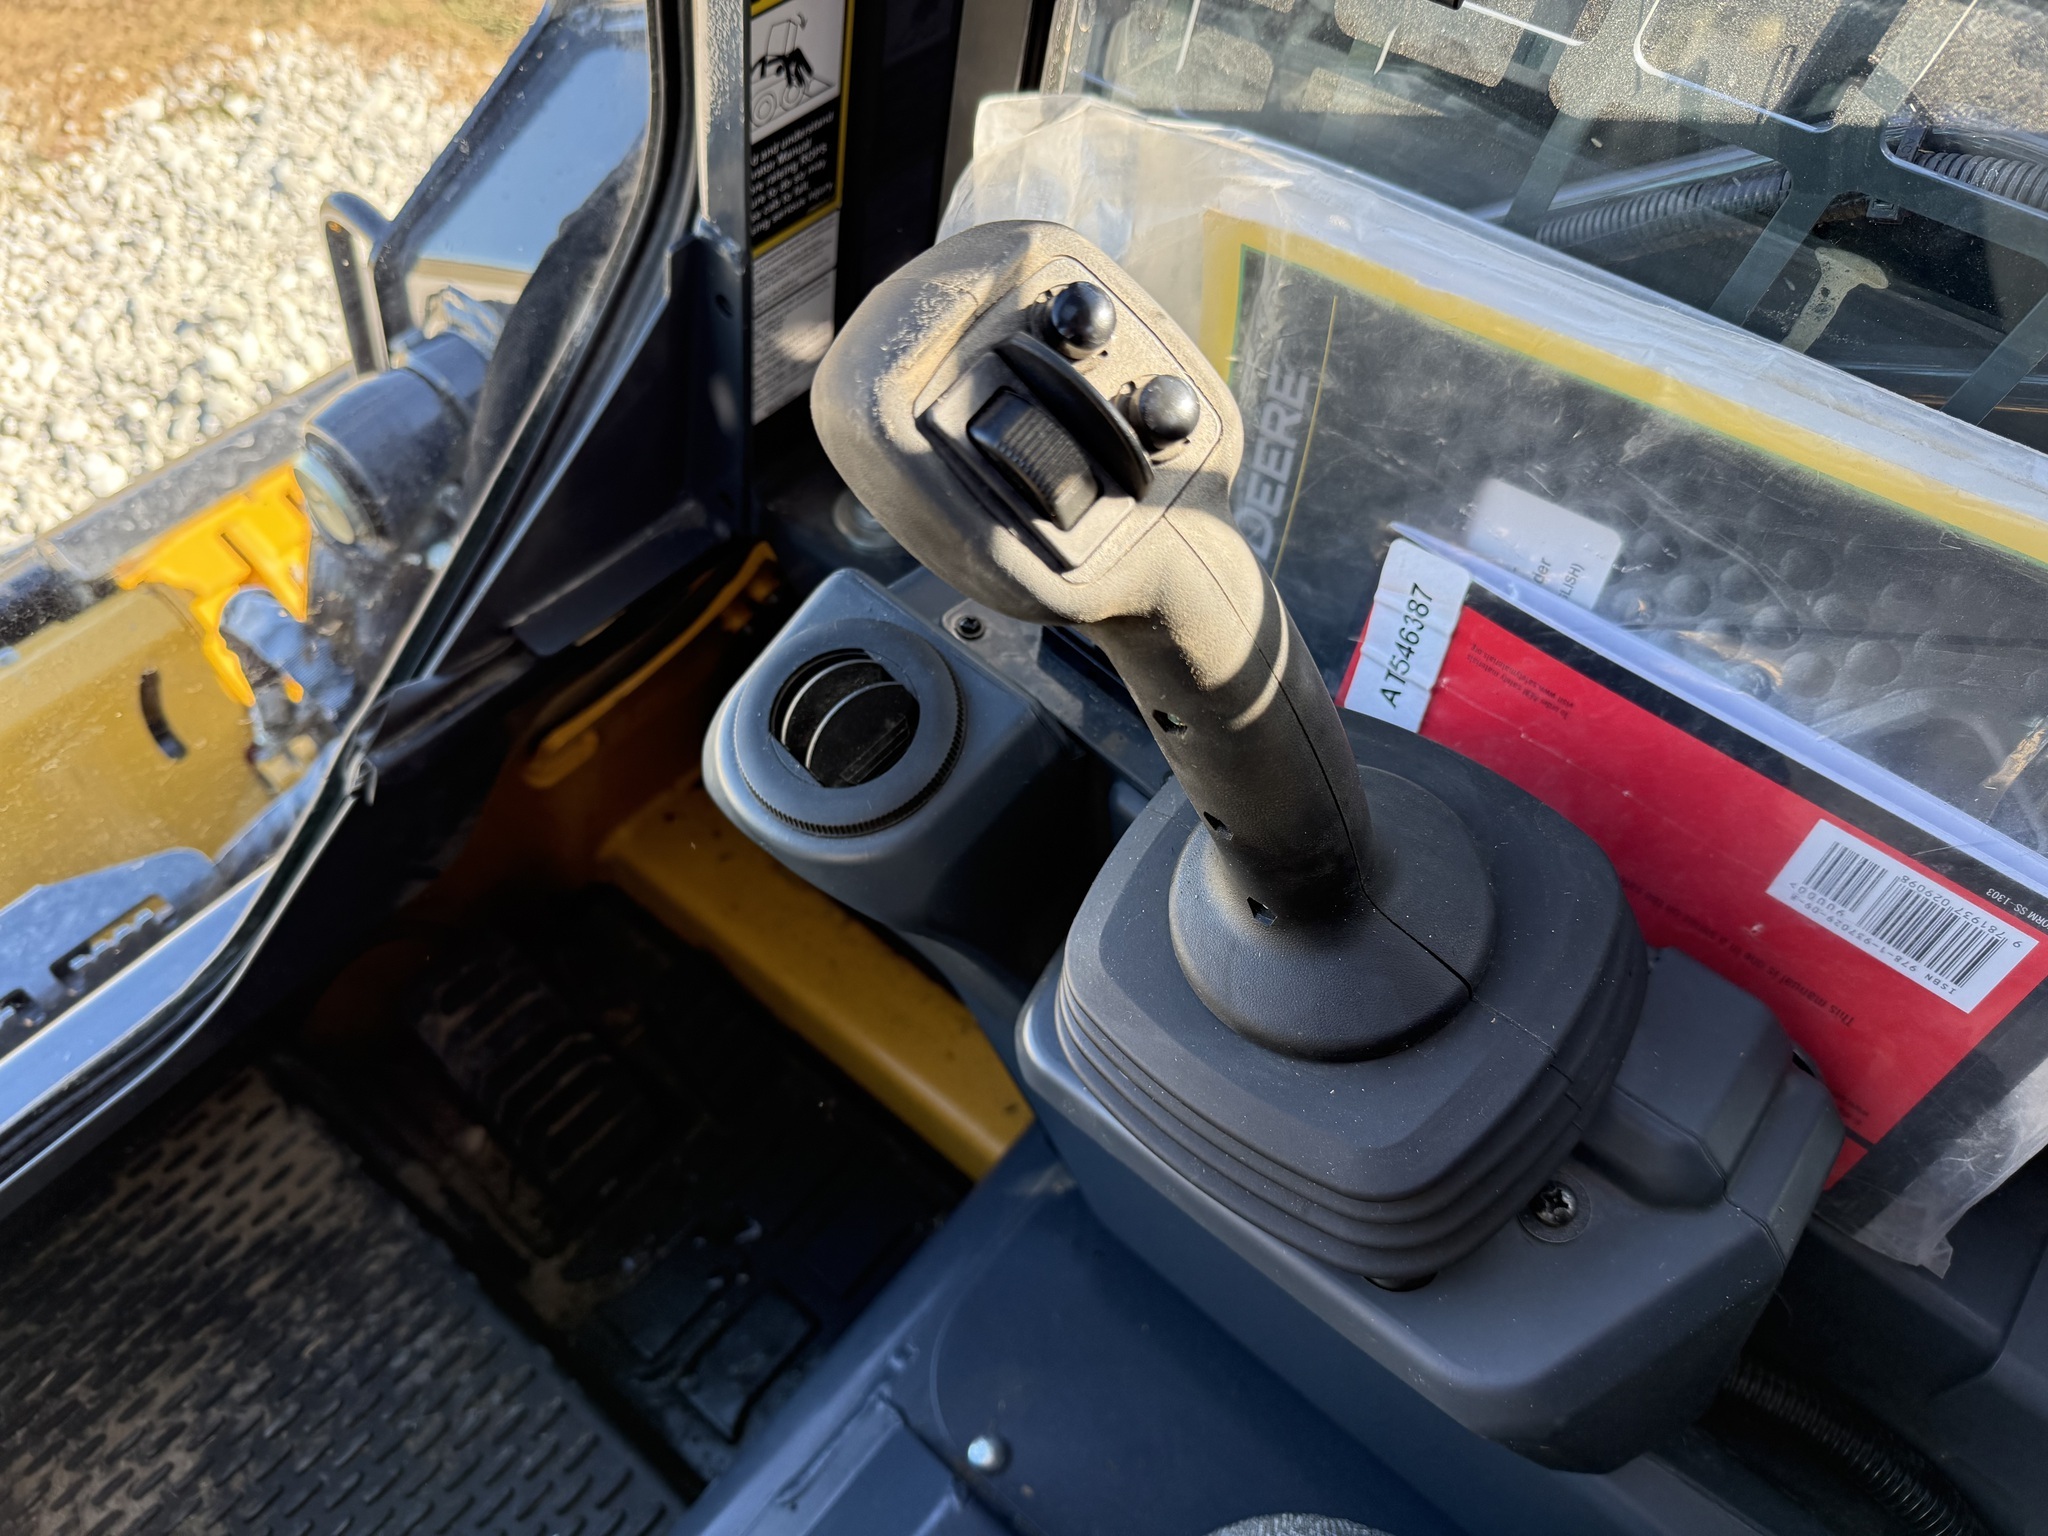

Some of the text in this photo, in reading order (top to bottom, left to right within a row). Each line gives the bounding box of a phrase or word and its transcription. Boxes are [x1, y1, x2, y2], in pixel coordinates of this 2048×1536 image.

[1234, 362, 1310, 560] DEERE
[1380, 582, 1433, 709] AT546387
[1901, 875, 2023, 948] 9 781937 029098
[2027, 911, 2048, 930] ORM
[1778, 974, 1829, 1007] manual
[1924, 973, 1957, 995] ISBN
[1829, 1004, 1855, 1027] This
